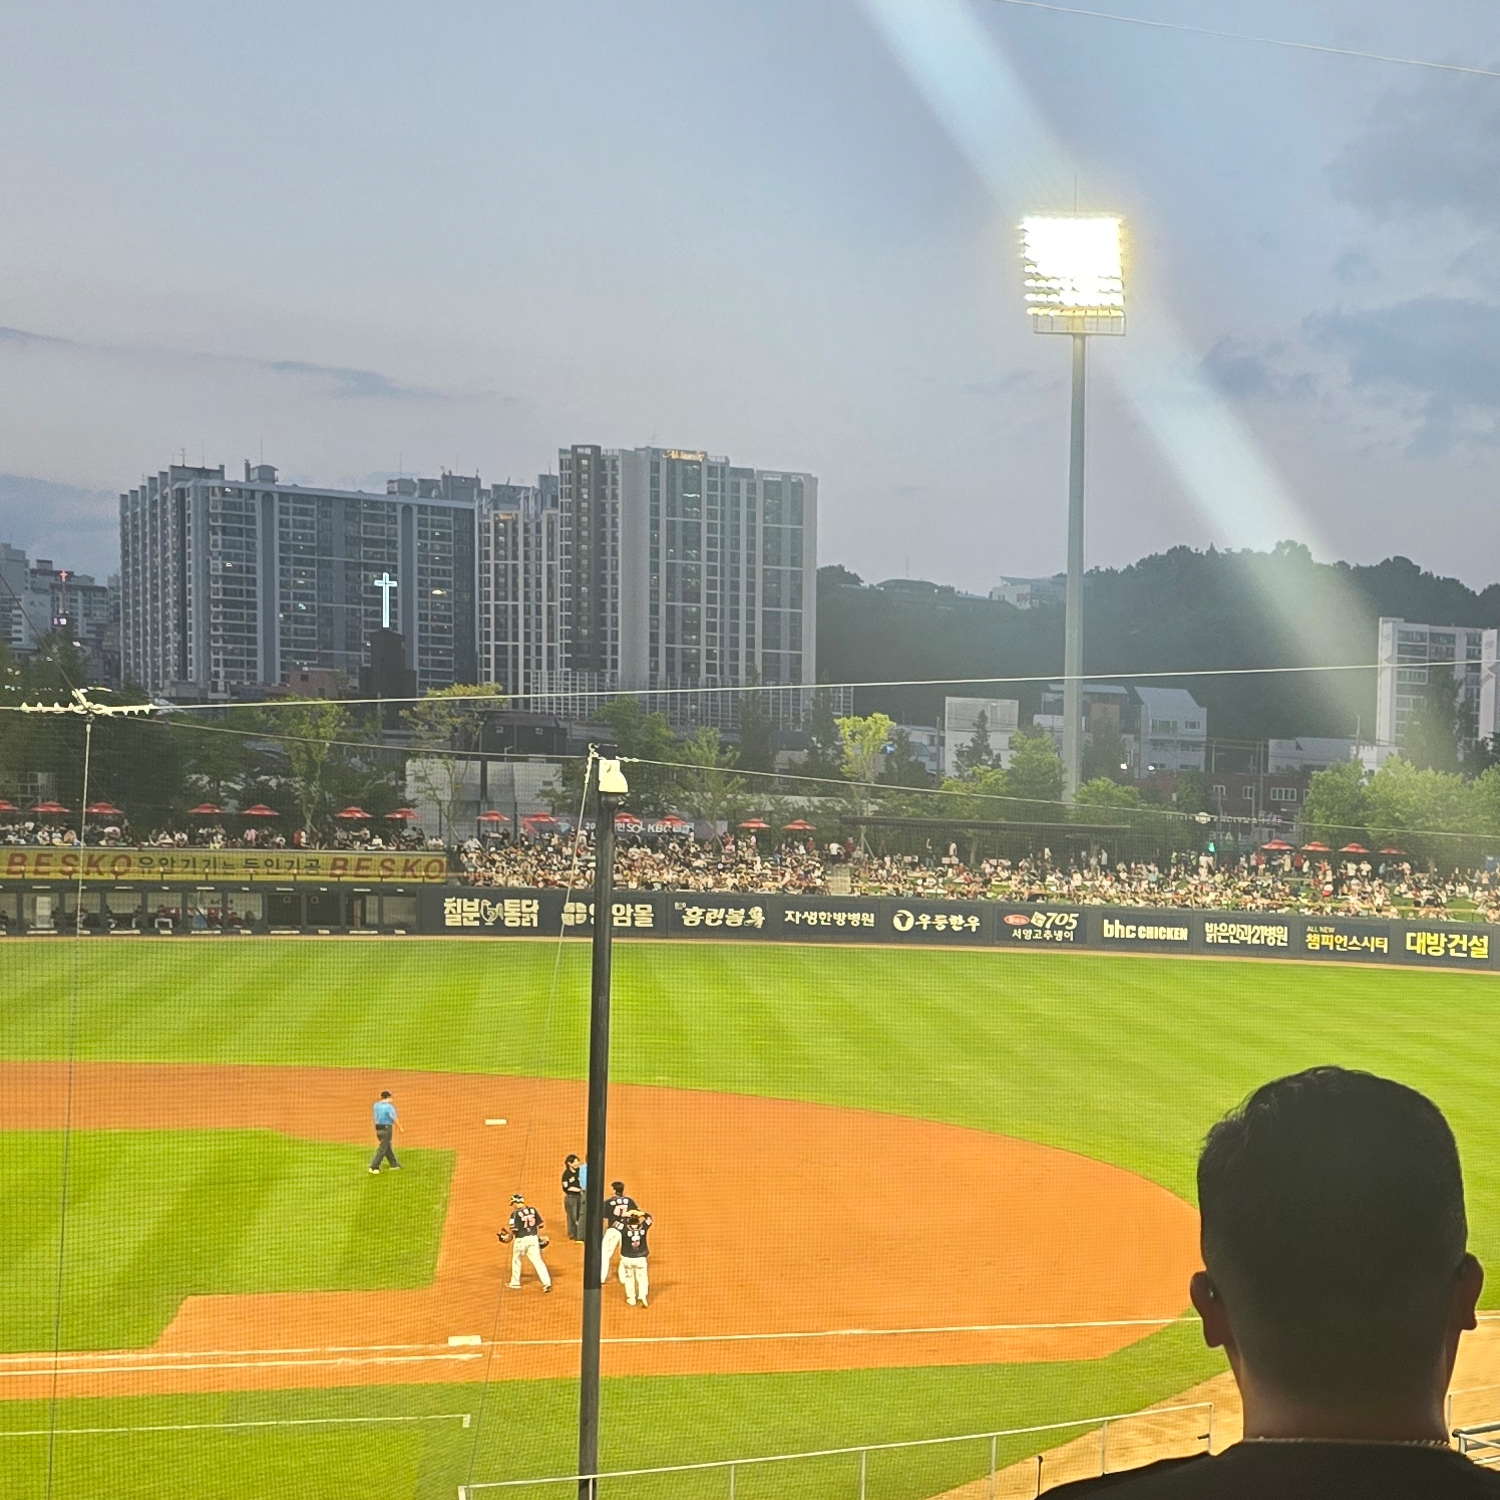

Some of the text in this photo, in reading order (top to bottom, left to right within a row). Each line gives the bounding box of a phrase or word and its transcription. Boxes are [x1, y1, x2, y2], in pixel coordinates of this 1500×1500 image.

[6, 852, 132, 877] BESKO
[329, 857, 445, 880] BESKO
[784, 910, 875, 927] 자생한방병원
[1045, 912, 1079, 931] 705
[1012, 929, 1074, 941] 서양고추냉이
[1103, 919, 1188, 941] bhc CHICKEN
[1205, 922, 1288, 946] 밝은안과21병원
[1305, 933, 1389, 954] 챔피언스시티
[1406, 931, 1489, 959] 대방건설
